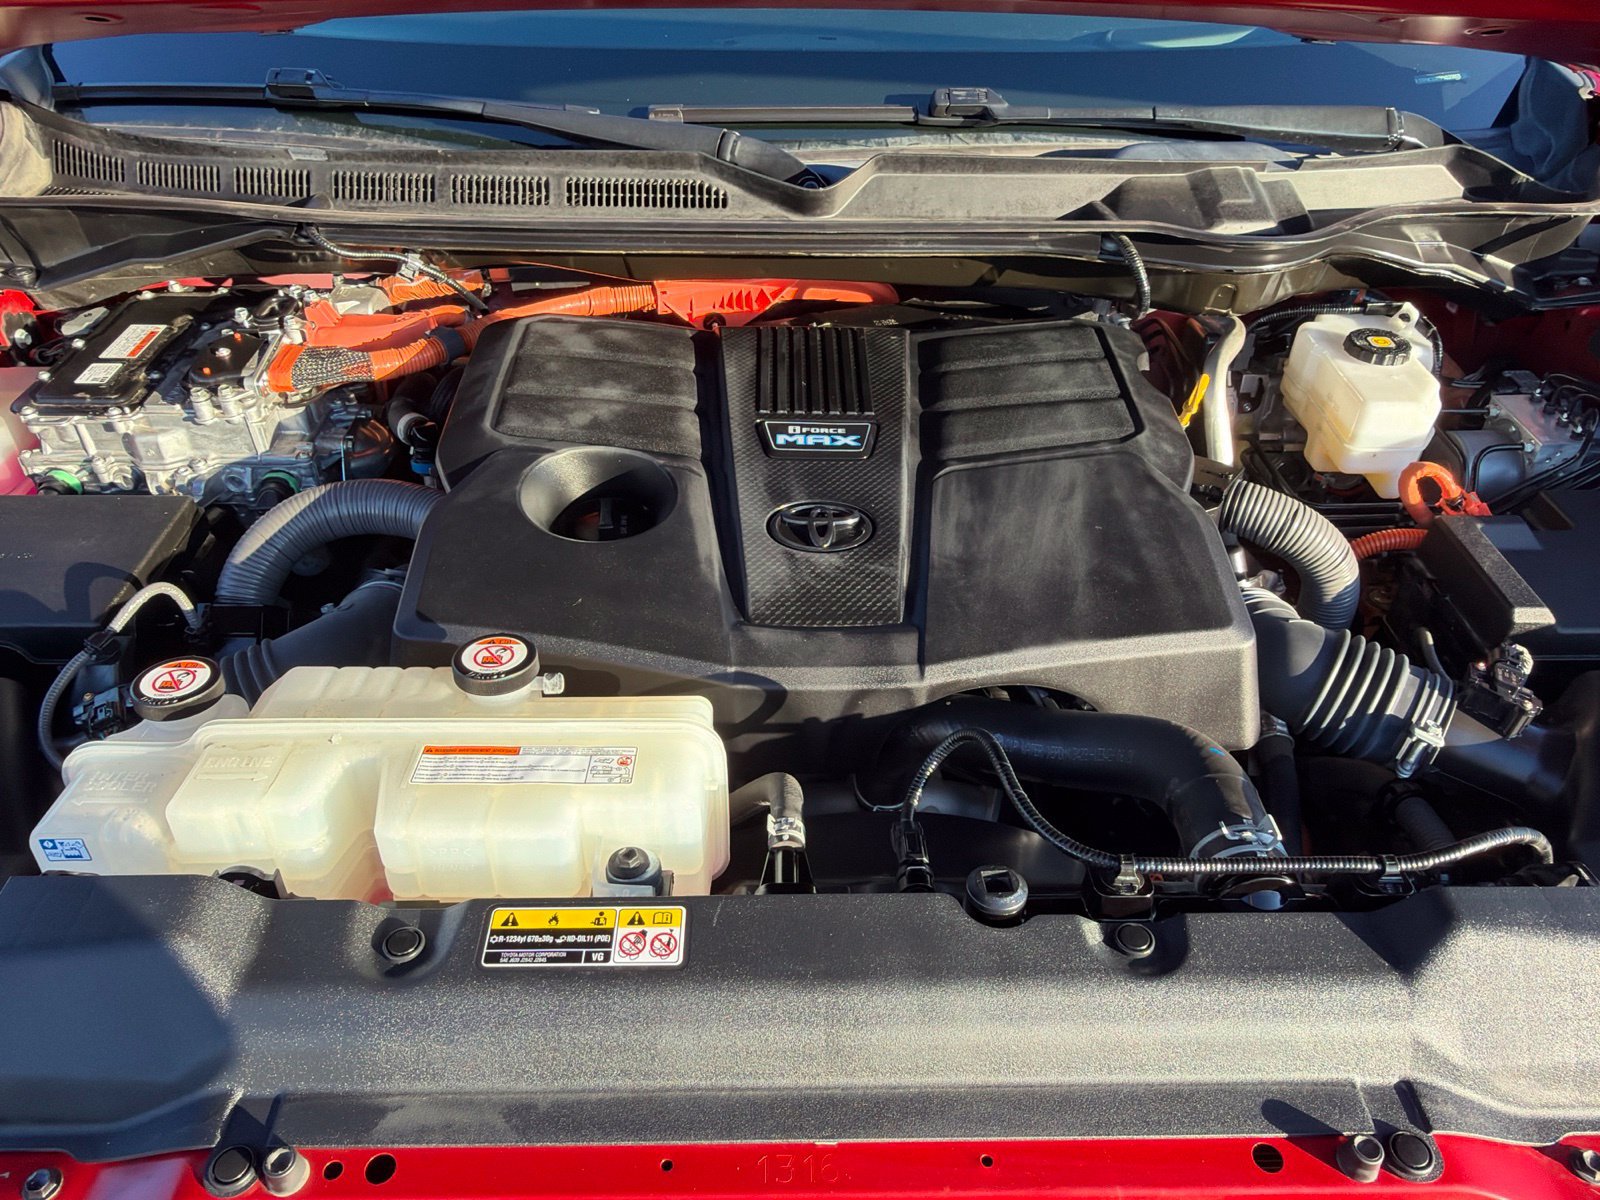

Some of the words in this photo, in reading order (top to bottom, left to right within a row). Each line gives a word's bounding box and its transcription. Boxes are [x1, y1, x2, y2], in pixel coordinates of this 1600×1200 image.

[776, 433, 861, 446] MAX
[203, 756, 275, 768] ENGINE
[592, 952, 605, 962] VG
